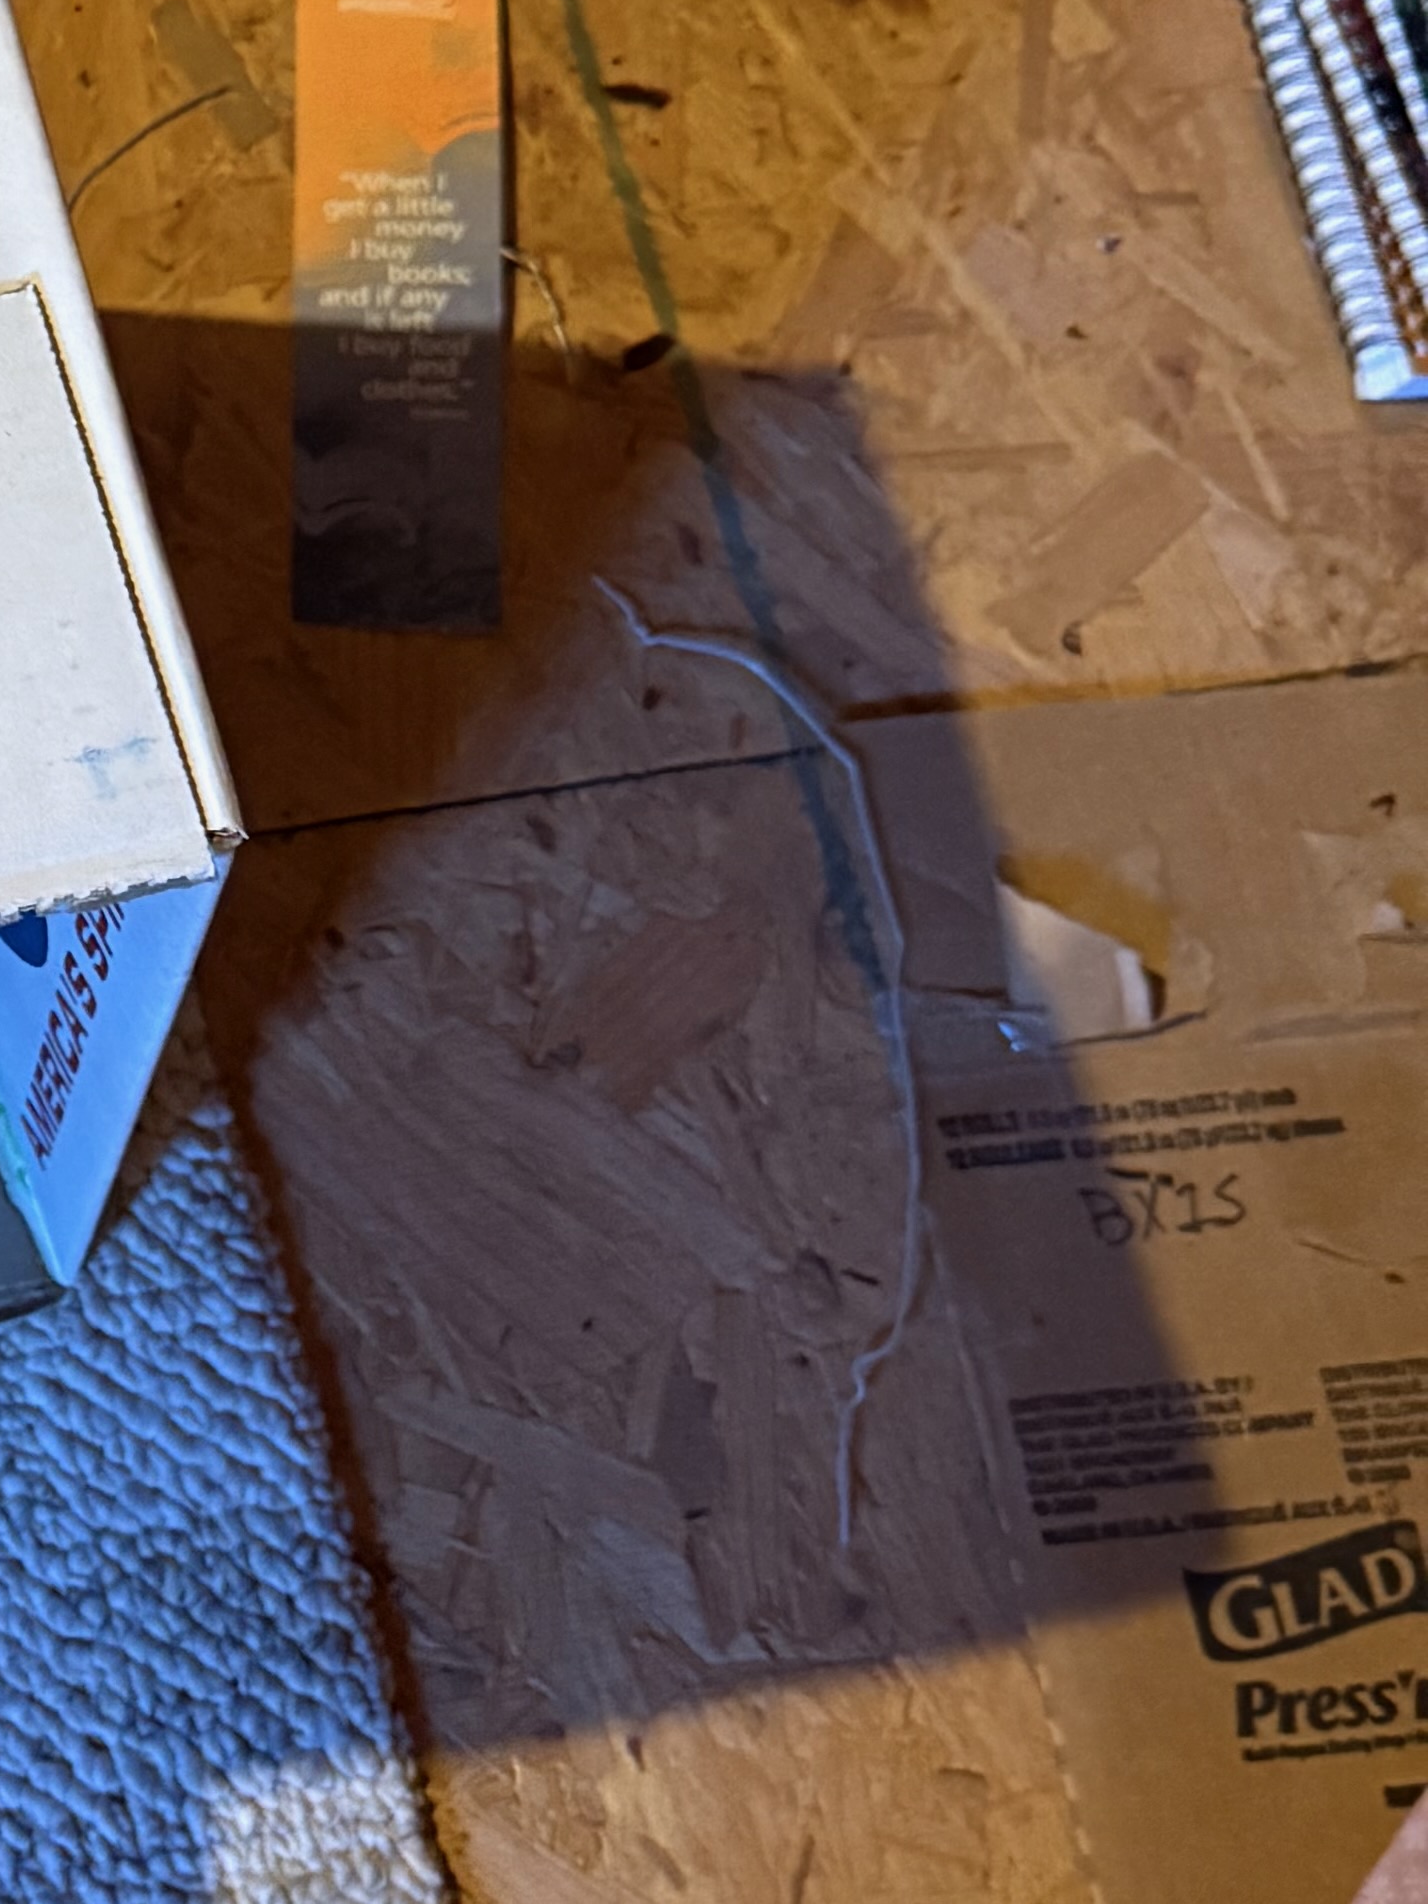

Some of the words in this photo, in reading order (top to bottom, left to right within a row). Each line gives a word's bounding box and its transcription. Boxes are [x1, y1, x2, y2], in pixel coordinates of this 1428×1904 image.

[321, 196, 370, 225] get
[370, 199, 391, 218] a
[394, 194, 457, 217] little
[374, 220, 469, 245] money
[362, 237, 416, 262] buy
[317, 286, 371, 309] and
[375, 284, 396, 308] if
[398, 289, 452, 313] any
[17, 963, 99, 1173] AMERICA'S
[1205, 1539, 1422, 1653] GLAD
